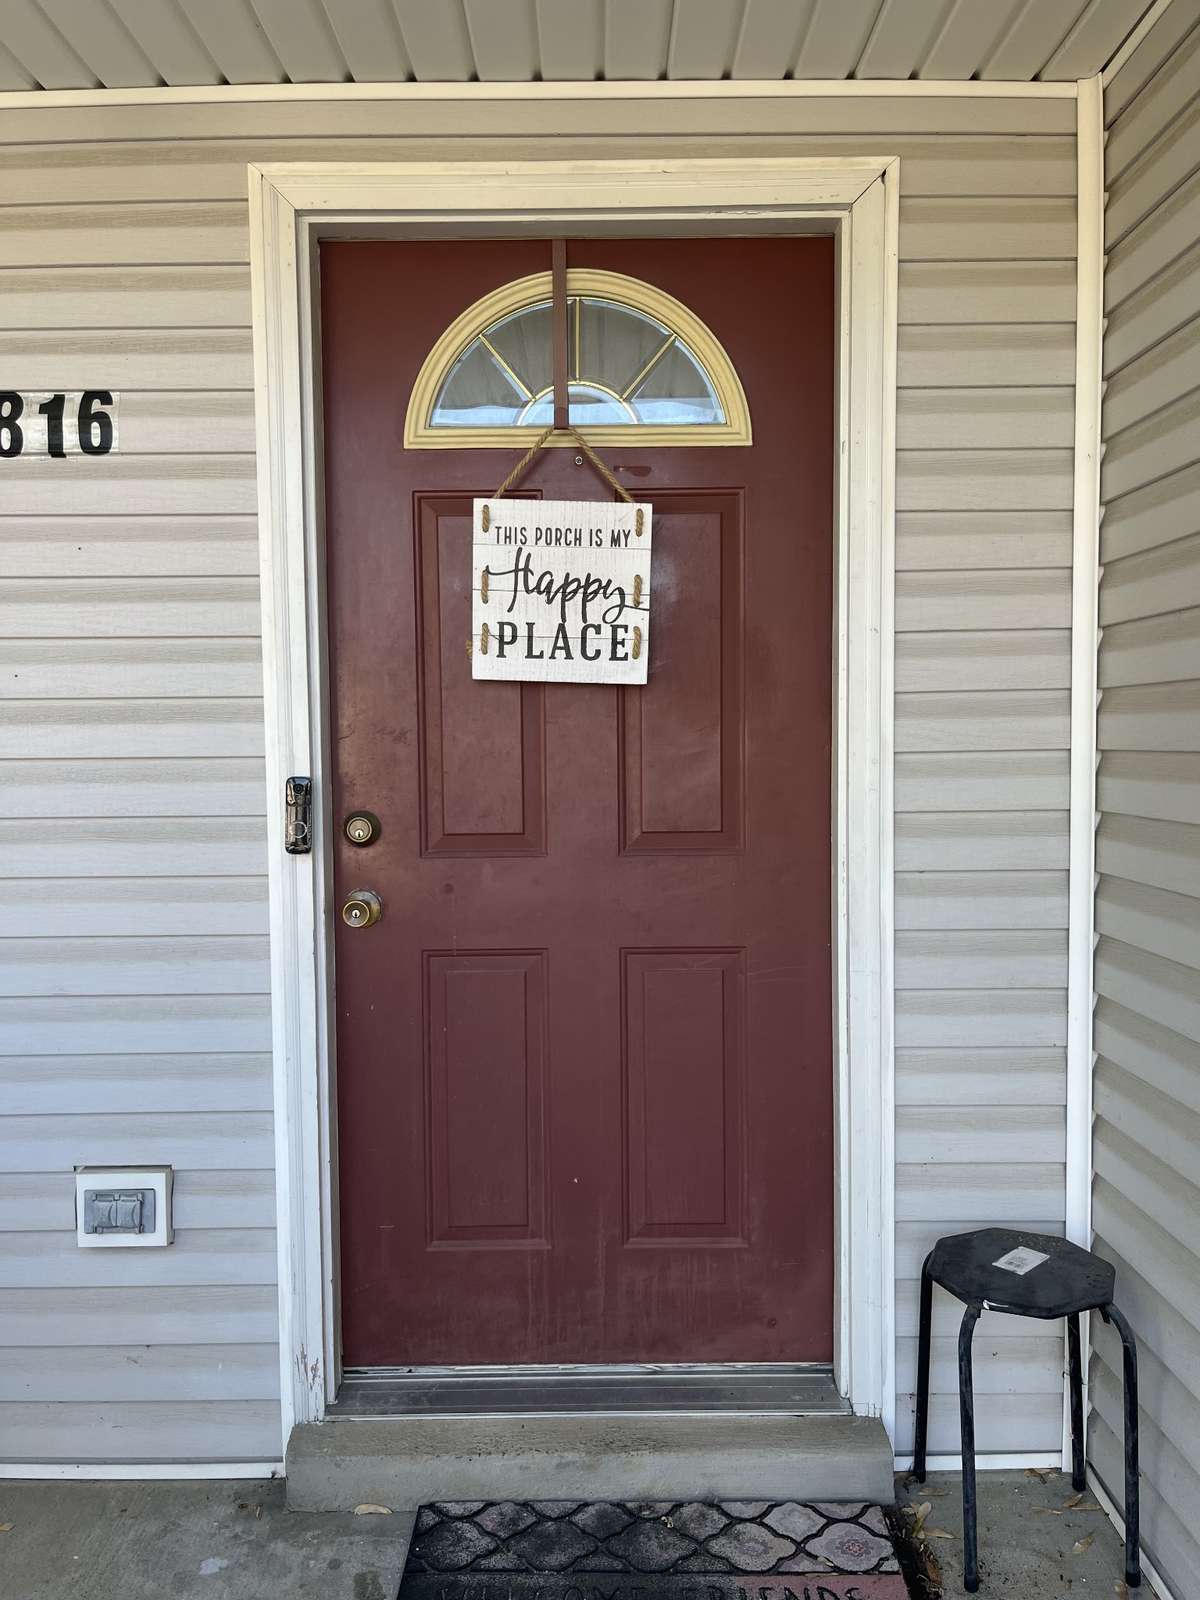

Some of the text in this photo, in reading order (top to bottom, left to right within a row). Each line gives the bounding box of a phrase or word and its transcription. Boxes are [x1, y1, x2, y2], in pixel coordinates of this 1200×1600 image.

[0, 391, 114, 458] 816
[494, 526, 631, 548] THIS PORCH IS MY
[485, 547, 650, 624] Happy
[496, 621, 629, 661] PLACE
